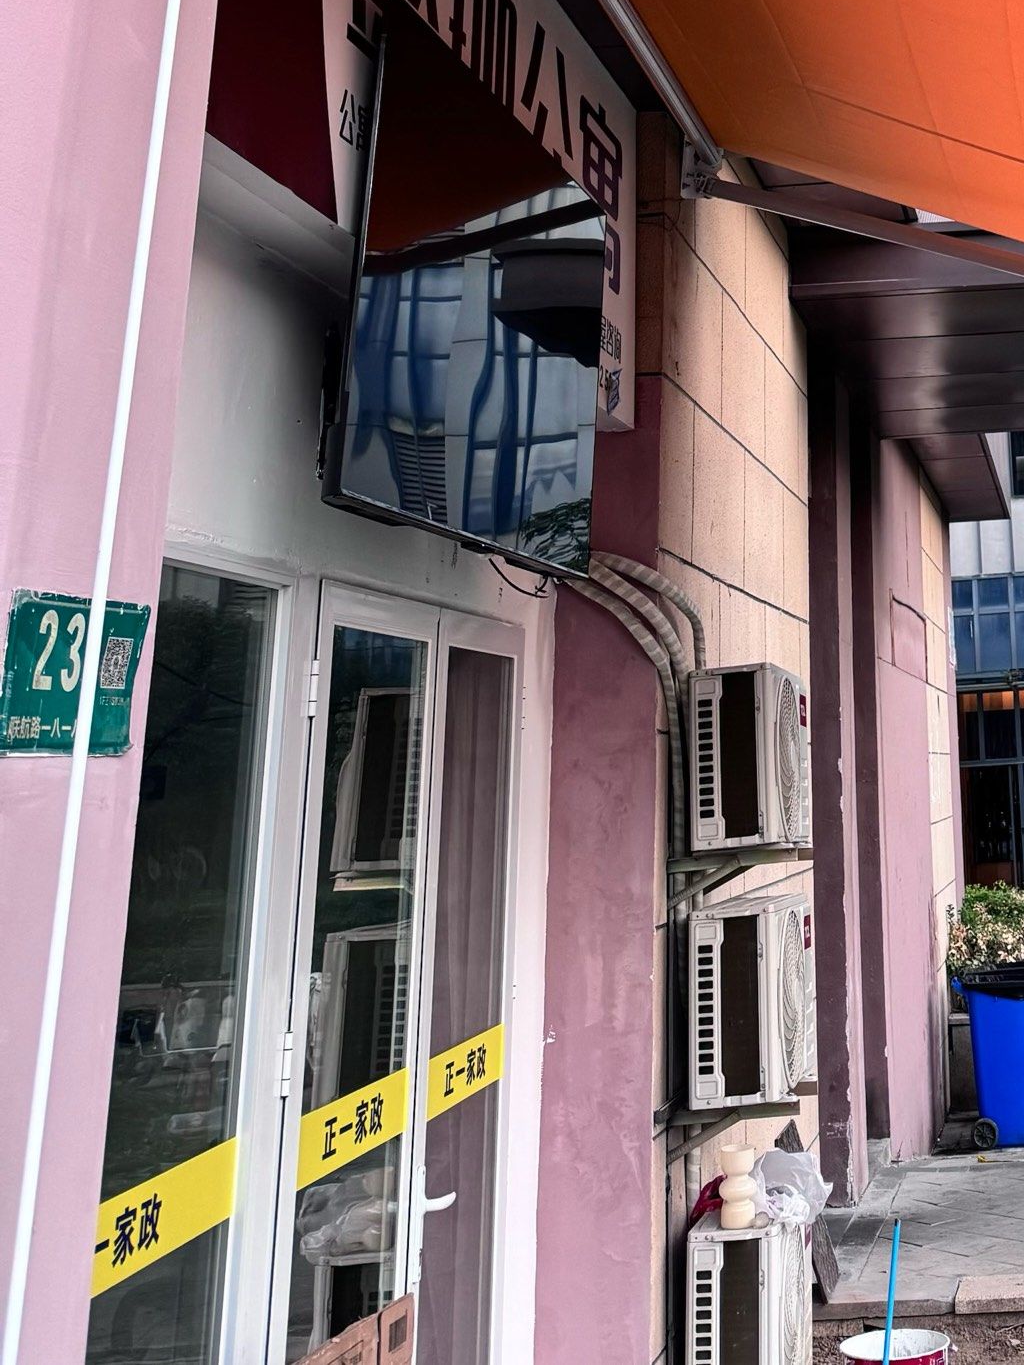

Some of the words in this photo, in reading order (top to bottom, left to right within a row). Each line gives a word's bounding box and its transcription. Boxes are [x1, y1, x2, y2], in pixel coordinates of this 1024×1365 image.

[32, 609, 86, 692] 23
[444, 1042, 486, 1097] 正一家政
[322, 1092, 384, 1160] 正一家政
[95, 1192, 163, 1267] 一家政
